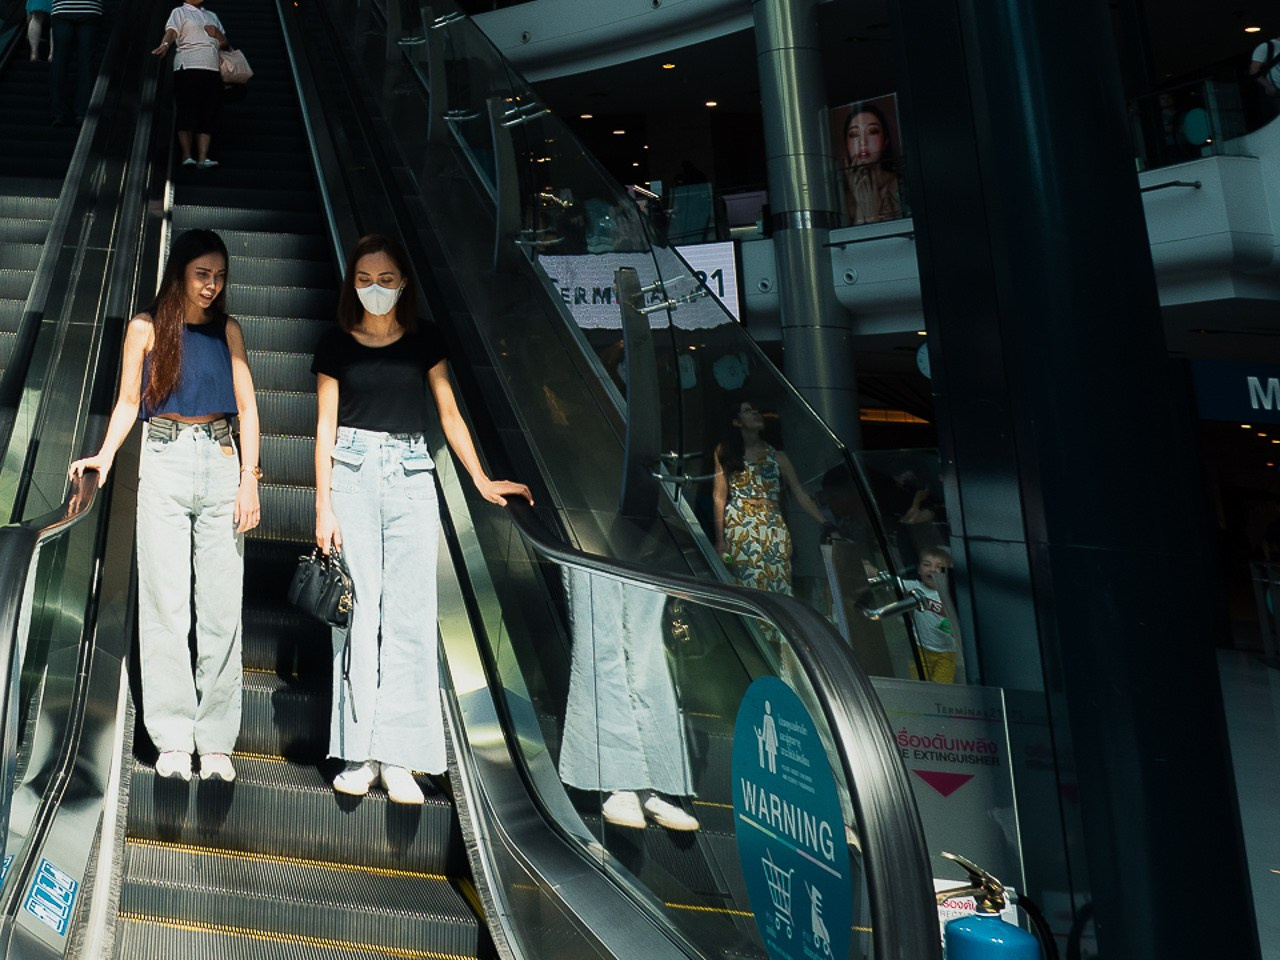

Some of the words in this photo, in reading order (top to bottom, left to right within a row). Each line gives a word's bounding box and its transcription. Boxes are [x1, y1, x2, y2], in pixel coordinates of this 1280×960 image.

[1246, 375, 1280, 411] M
[914, 750, 1001, 766] EXTINGUISHER
[740, 777, 836, 863] WARNING
